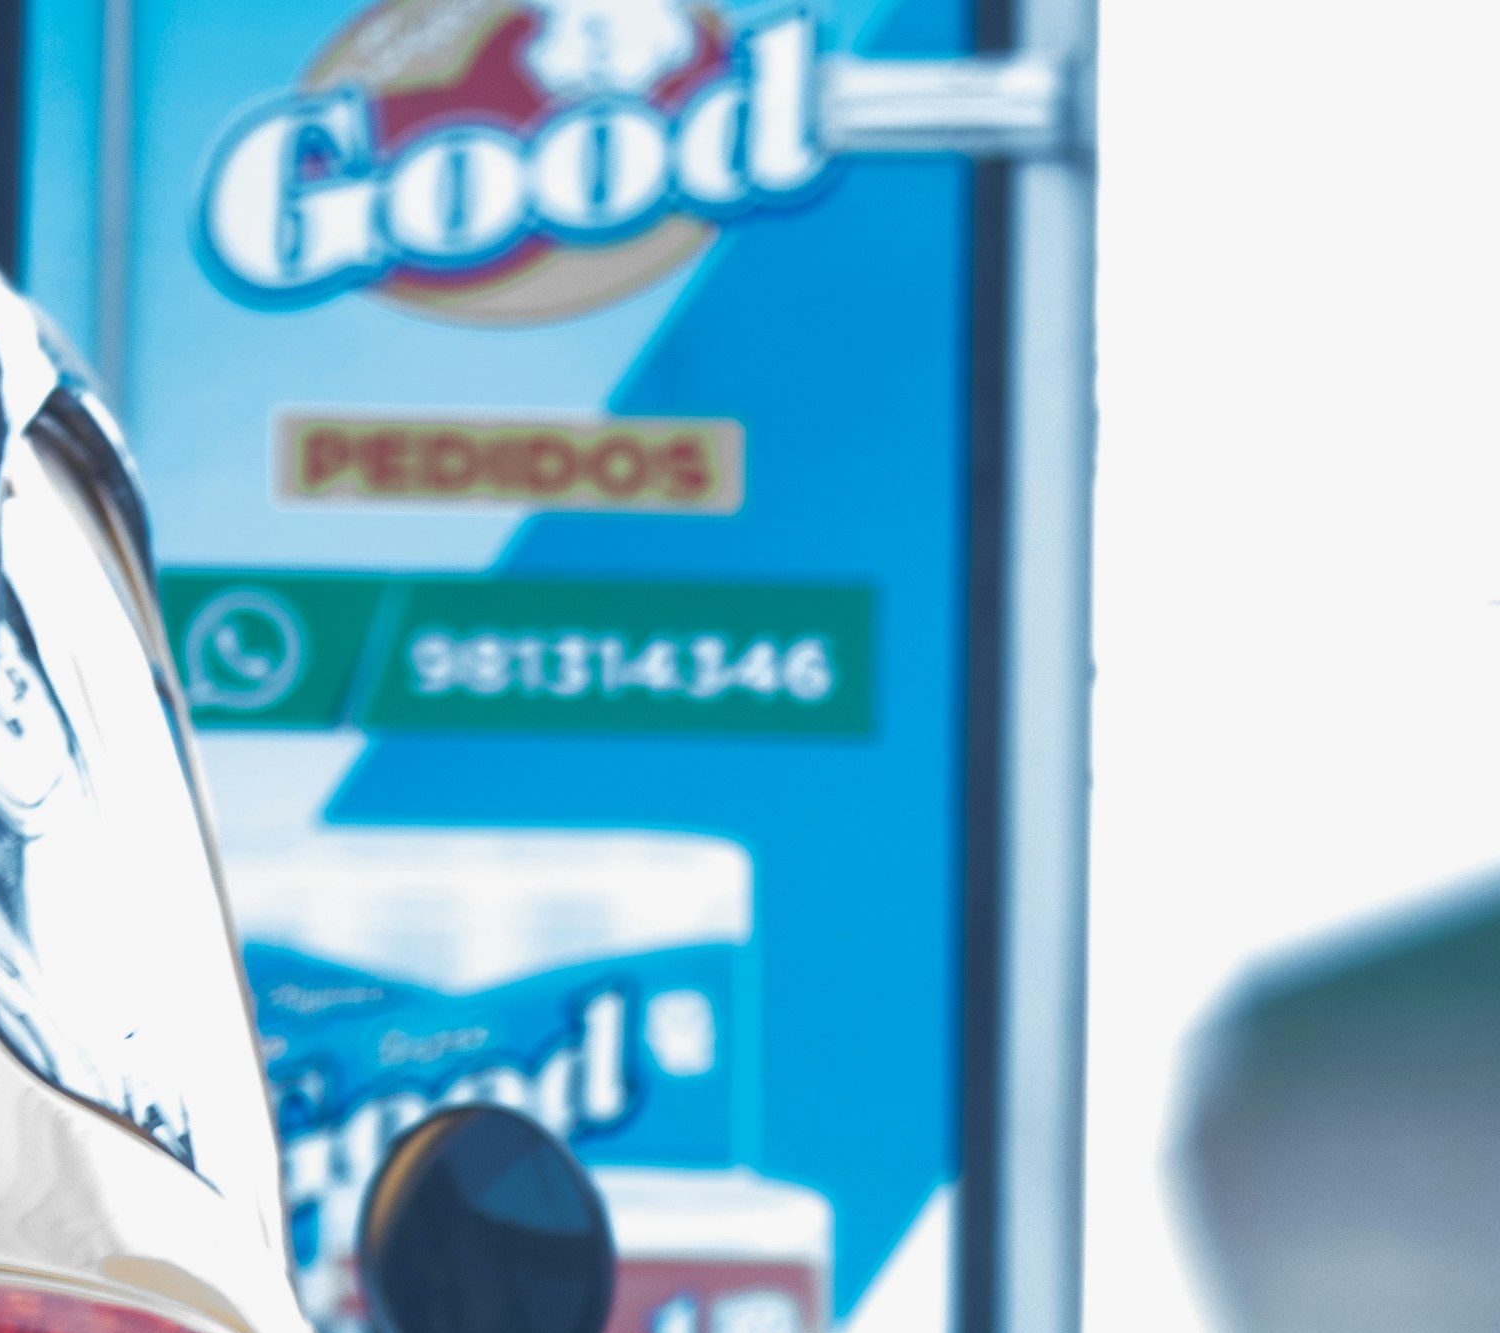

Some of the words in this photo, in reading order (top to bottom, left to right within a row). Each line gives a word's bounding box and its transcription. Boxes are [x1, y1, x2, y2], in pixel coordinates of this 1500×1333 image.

[202, 12, 820, 292] Good
[300, 428, 716, 502] PEDIDOS
[408, 630, 834, 700] 981314346
